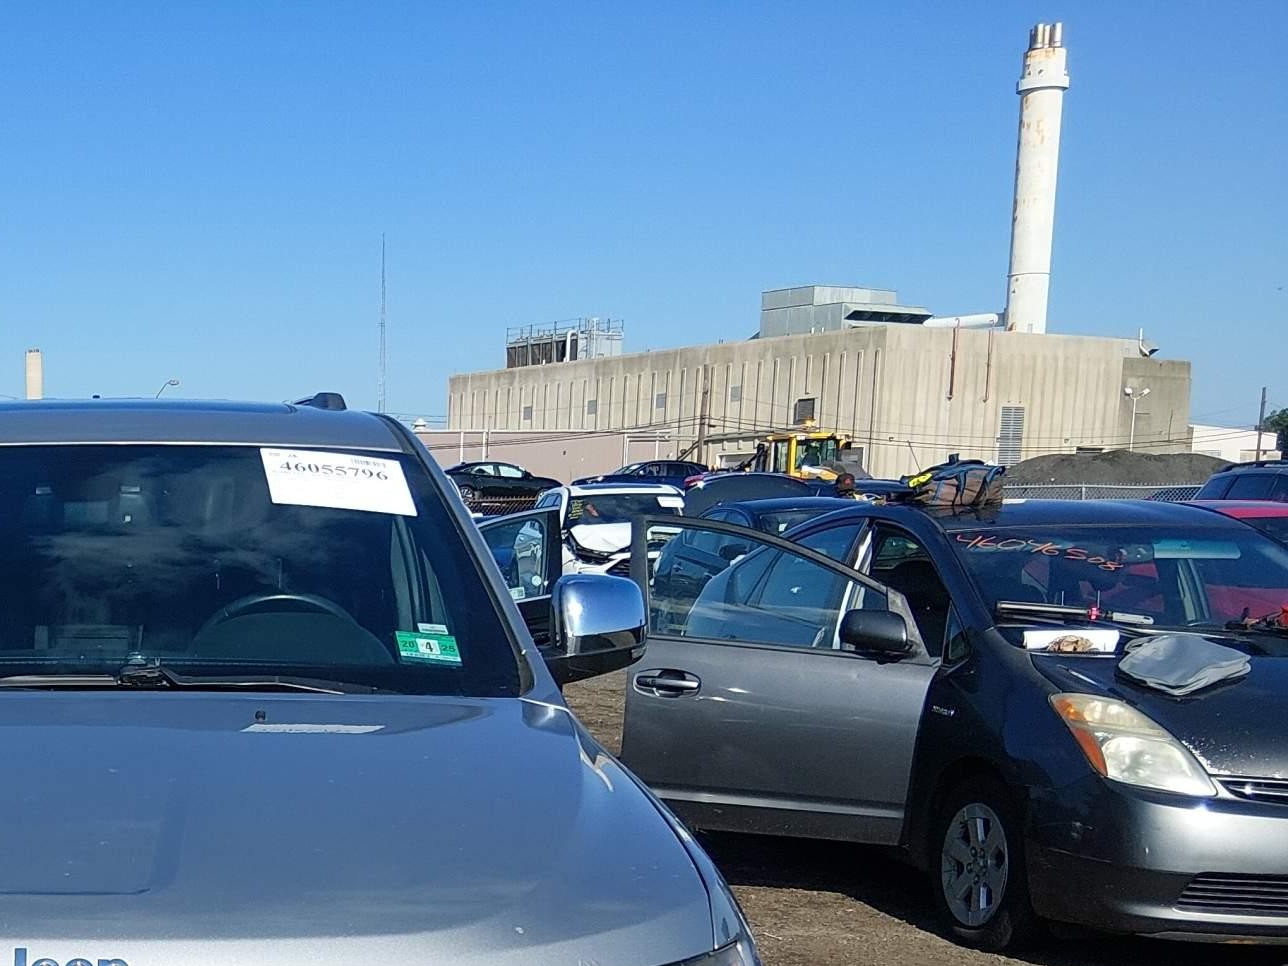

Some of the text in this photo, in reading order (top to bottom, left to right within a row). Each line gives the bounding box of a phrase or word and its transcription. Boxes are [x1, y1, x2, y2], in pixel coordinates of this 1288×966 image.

[279, 460, 389, 481] 46055796
[956, 534, 1124, 571] 46046508
[401, 640, 456, 653] 20 4 25
